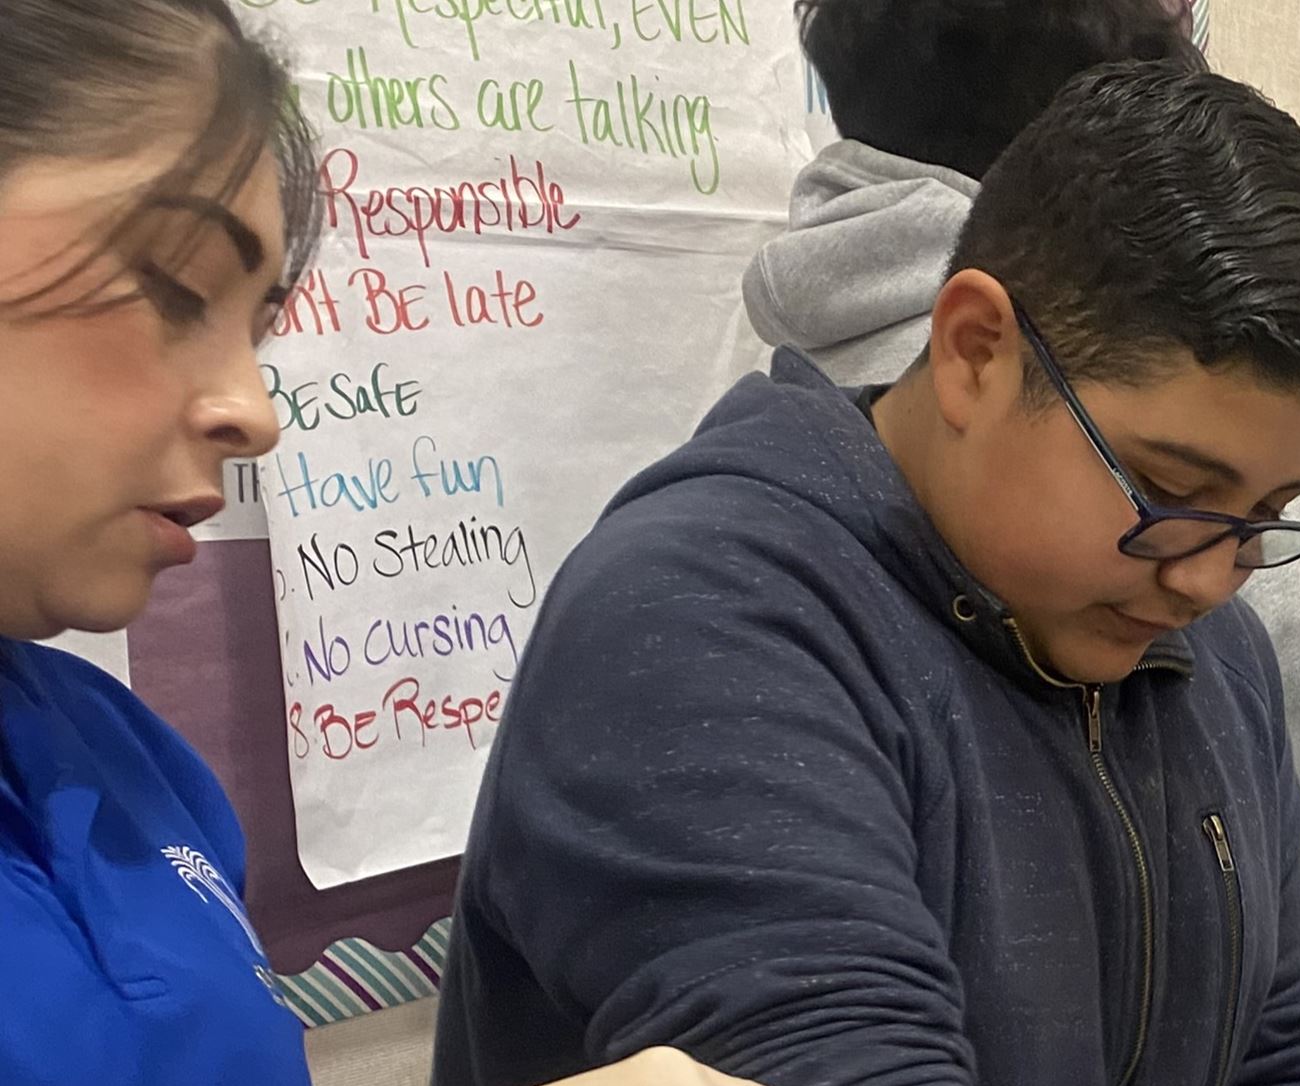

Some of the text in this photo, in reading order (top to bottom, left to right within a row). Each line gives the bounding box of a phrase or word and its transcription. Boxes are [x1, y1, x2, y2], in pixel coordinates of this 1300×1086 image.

[632, 0, 752, 46] EVEN
[326, 46, 460, 130] others
[477, 79, 554, 131] are
[318, 148, 580, 266] Responsible
[272, 268, 543, 337] on't BE late
[277, 435, 504, 518] Have fun
[373, 516, 537, 608] Stealing
[314, 703, 379, 760] BE
[383, 677, 500, 750] Respe
